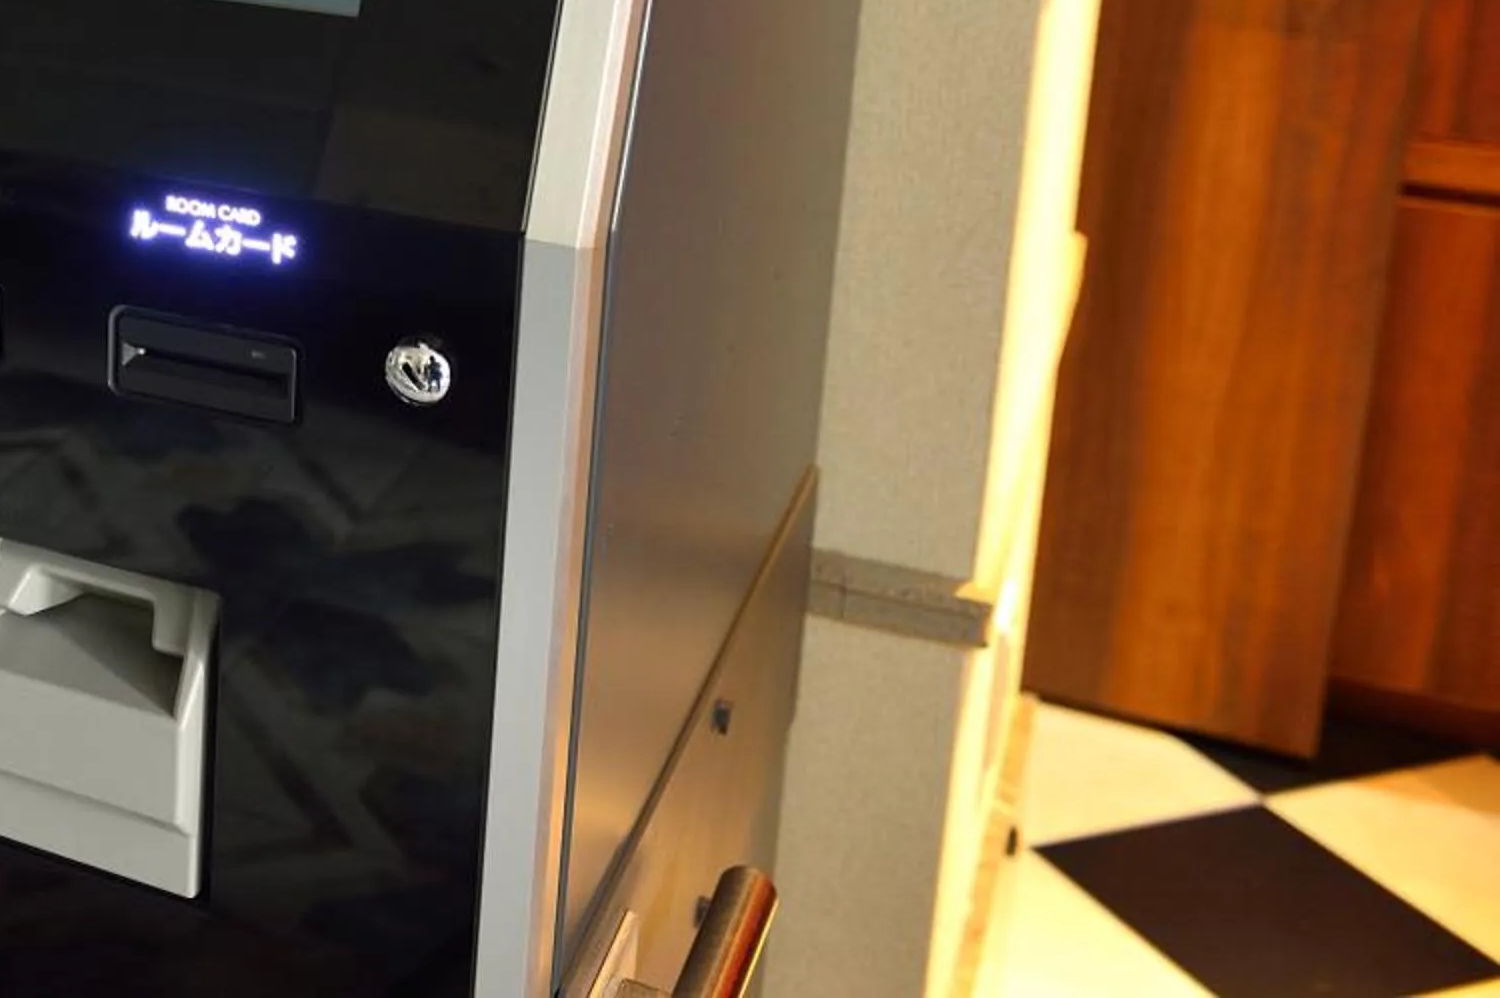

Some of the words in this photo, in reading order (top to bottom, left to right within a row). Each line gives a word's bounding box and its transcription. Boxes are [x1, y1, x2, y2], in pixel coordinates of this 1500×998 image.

[165, 195, 216, 218] ROOM
[217, 204, 262, 227] CARD
[130, 209, 297, 265] ルームカード
